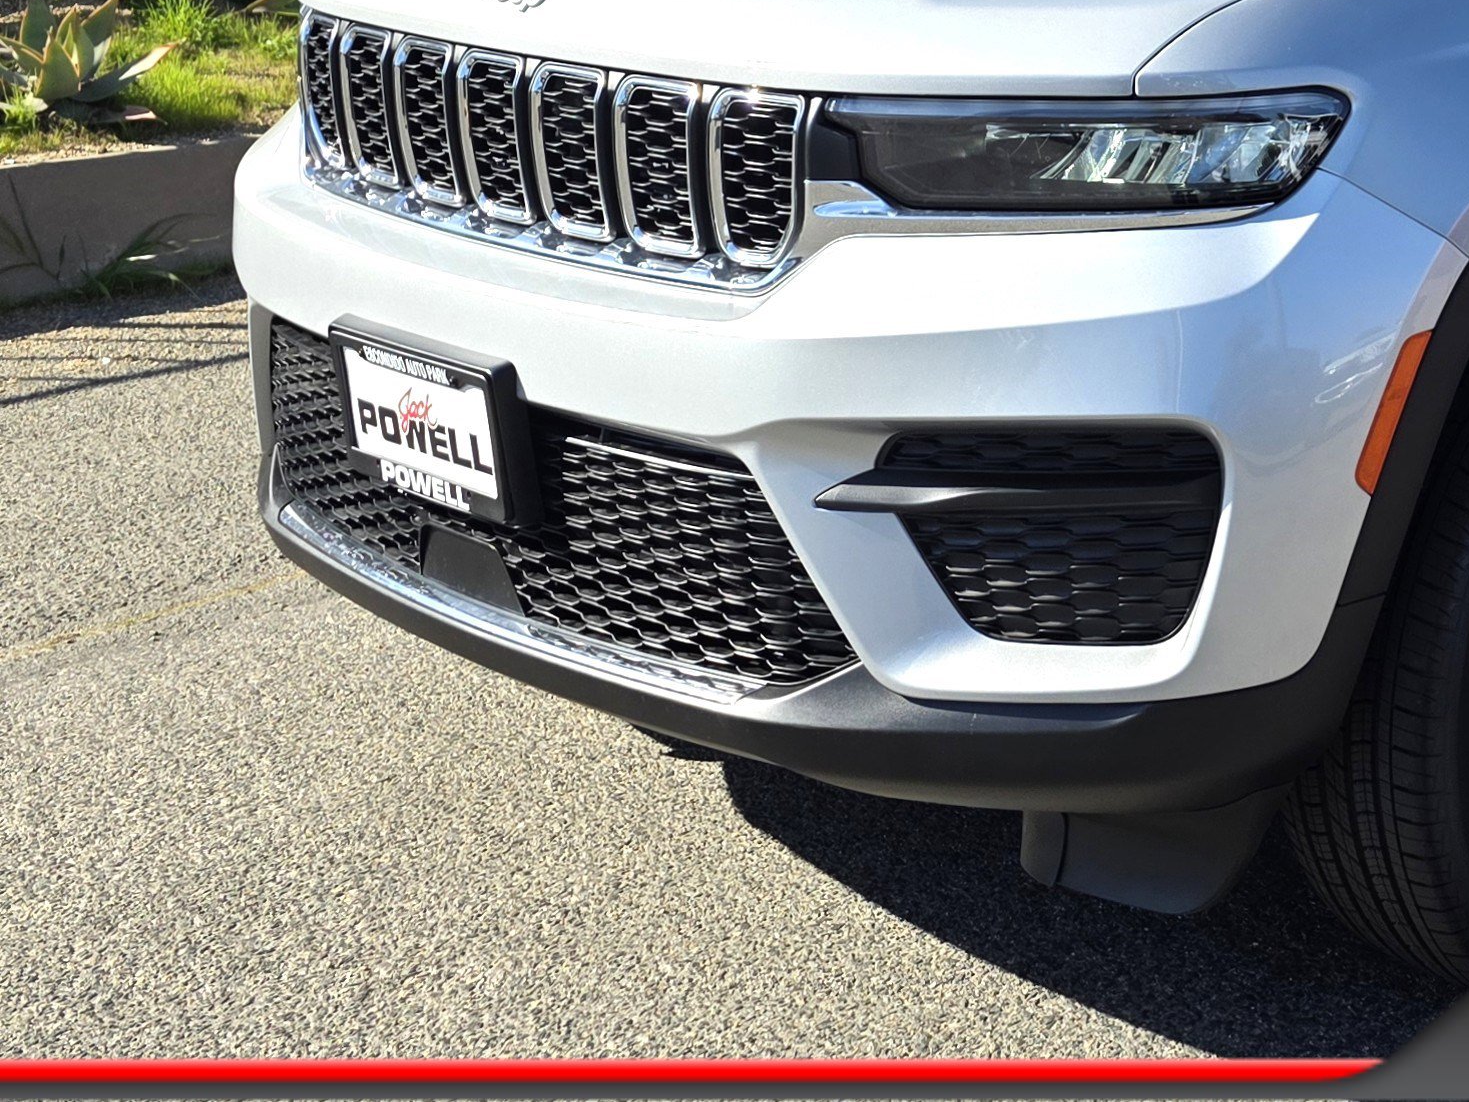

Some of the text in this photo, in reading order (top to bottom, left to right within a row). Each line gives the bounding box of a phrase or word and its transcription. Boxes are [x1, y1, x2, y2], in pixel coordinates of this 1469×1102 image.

[363, 346, 451, 386] ESCONDIDO AUTO PARK
[398, 387, 438, 434] Jack
[357, 398, 494, 476] POWELL
[380, 459, 473, 514] POWELL
